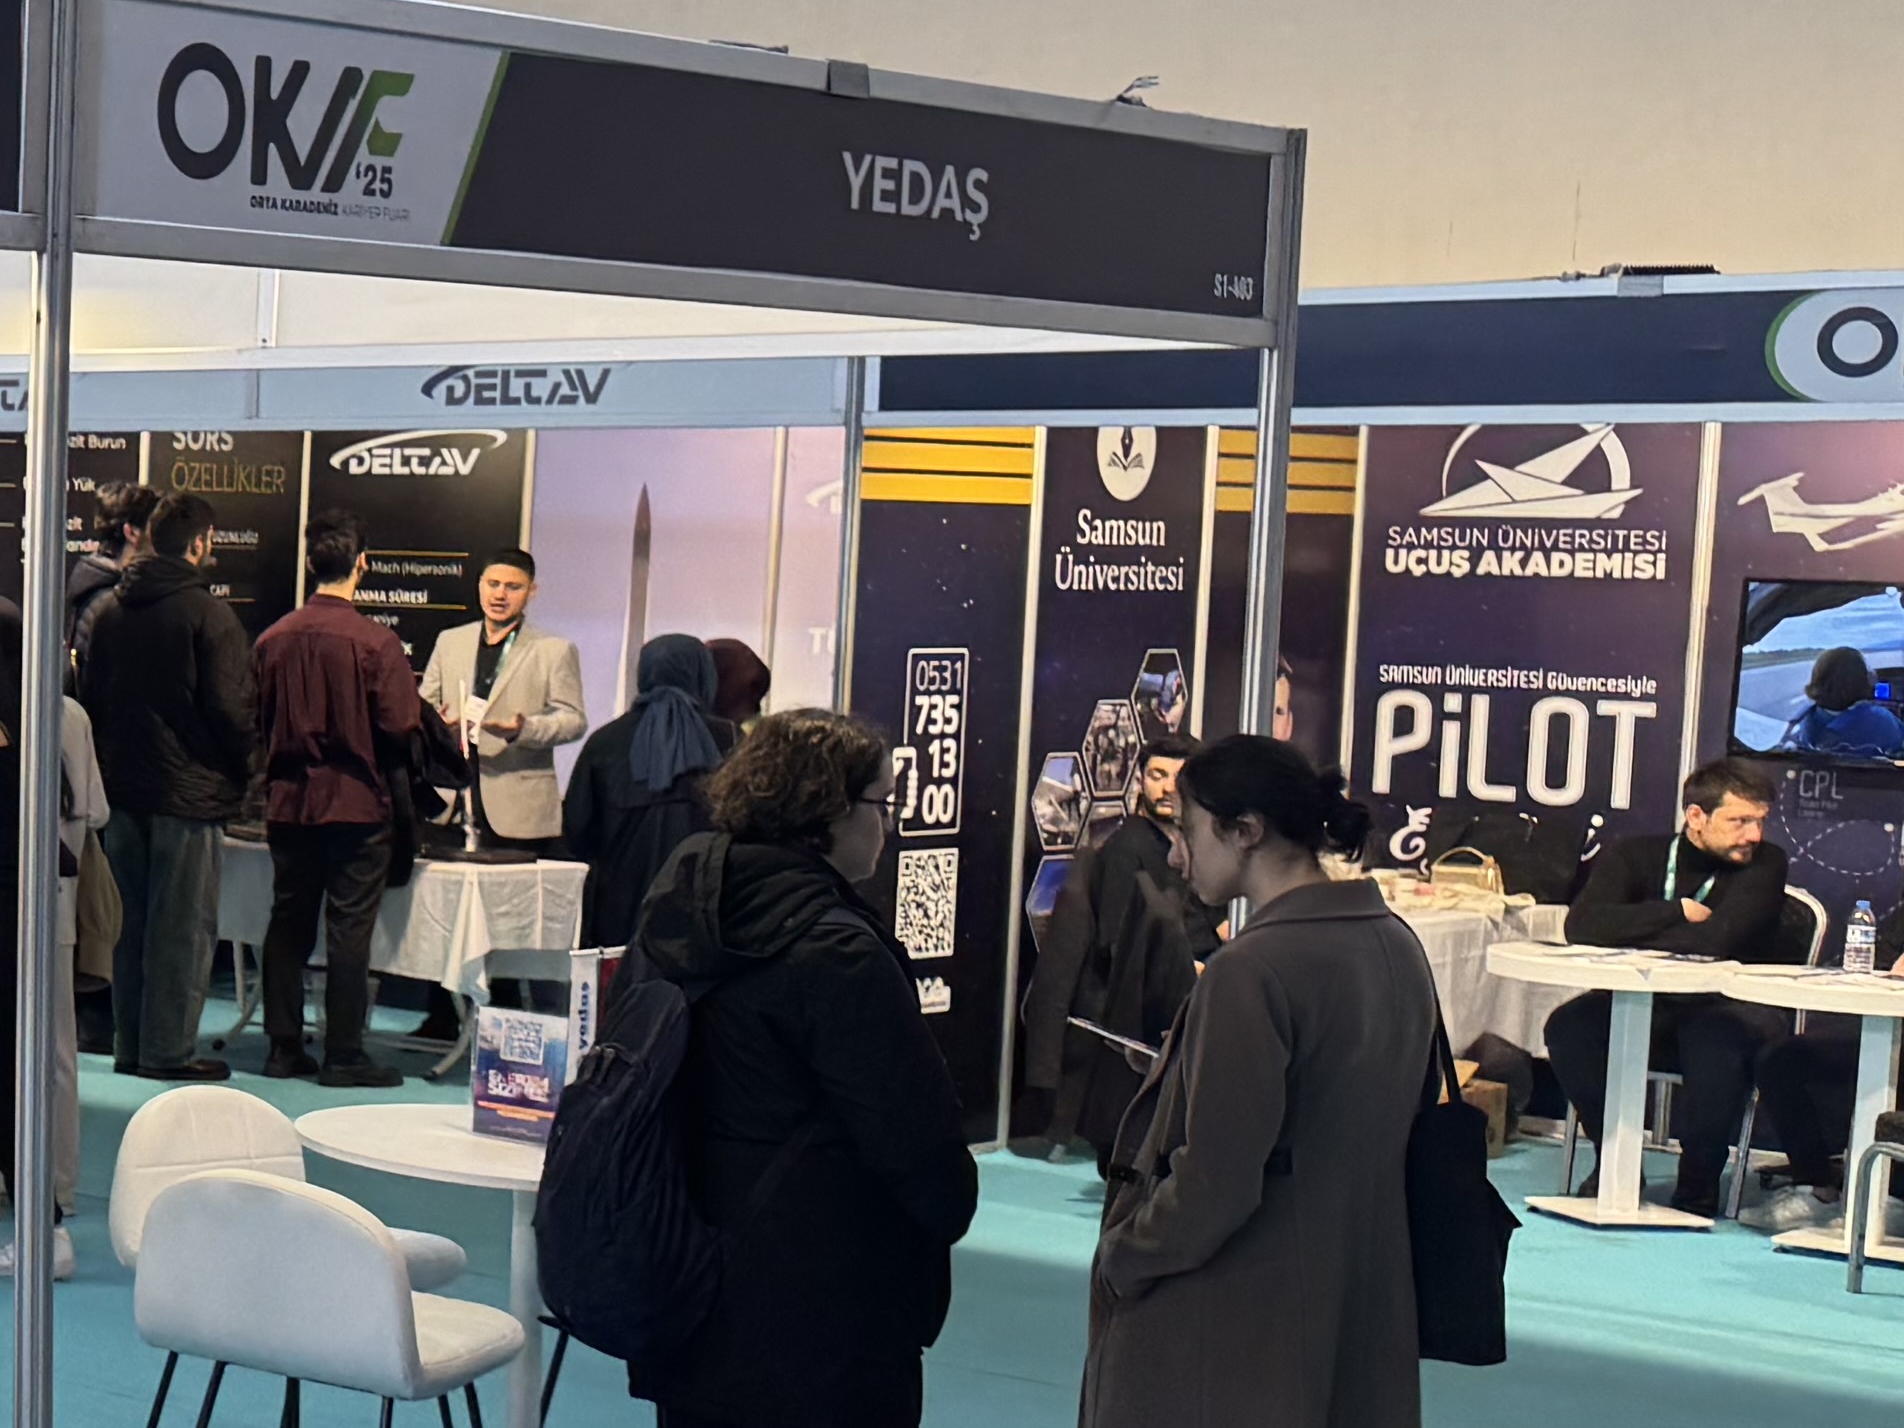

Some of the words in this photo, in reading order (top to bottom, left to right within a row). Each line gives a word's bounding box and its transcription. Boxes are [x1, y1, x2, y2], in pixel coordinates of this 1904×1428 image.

[842, 151, 990, 241] YEDAŞ
[445, 368, 611, 406] DELTAV
[171, 456, 286, 494] ÖZELLİKLER
[348, 447, 481, 475] DELTAV
[1077, 508, 1166, 546] Samsun
[1387, 525, 1488, 548] SAMSUN
[1497, 524, 1667, 551] ÜNİVERSİTESİ
[1055, 546, 1185, 591] Üniversitesi
[1385, 548, 1471, 578] UÇUŞ
[1476, 549, 1666, 580] AKADEMİSİ
[916, 659, 963, 692] 0531
[914, 695, 960, 735] 735
[928, 738, 957, 778] 13
[922, 783, 955, 824] 00
